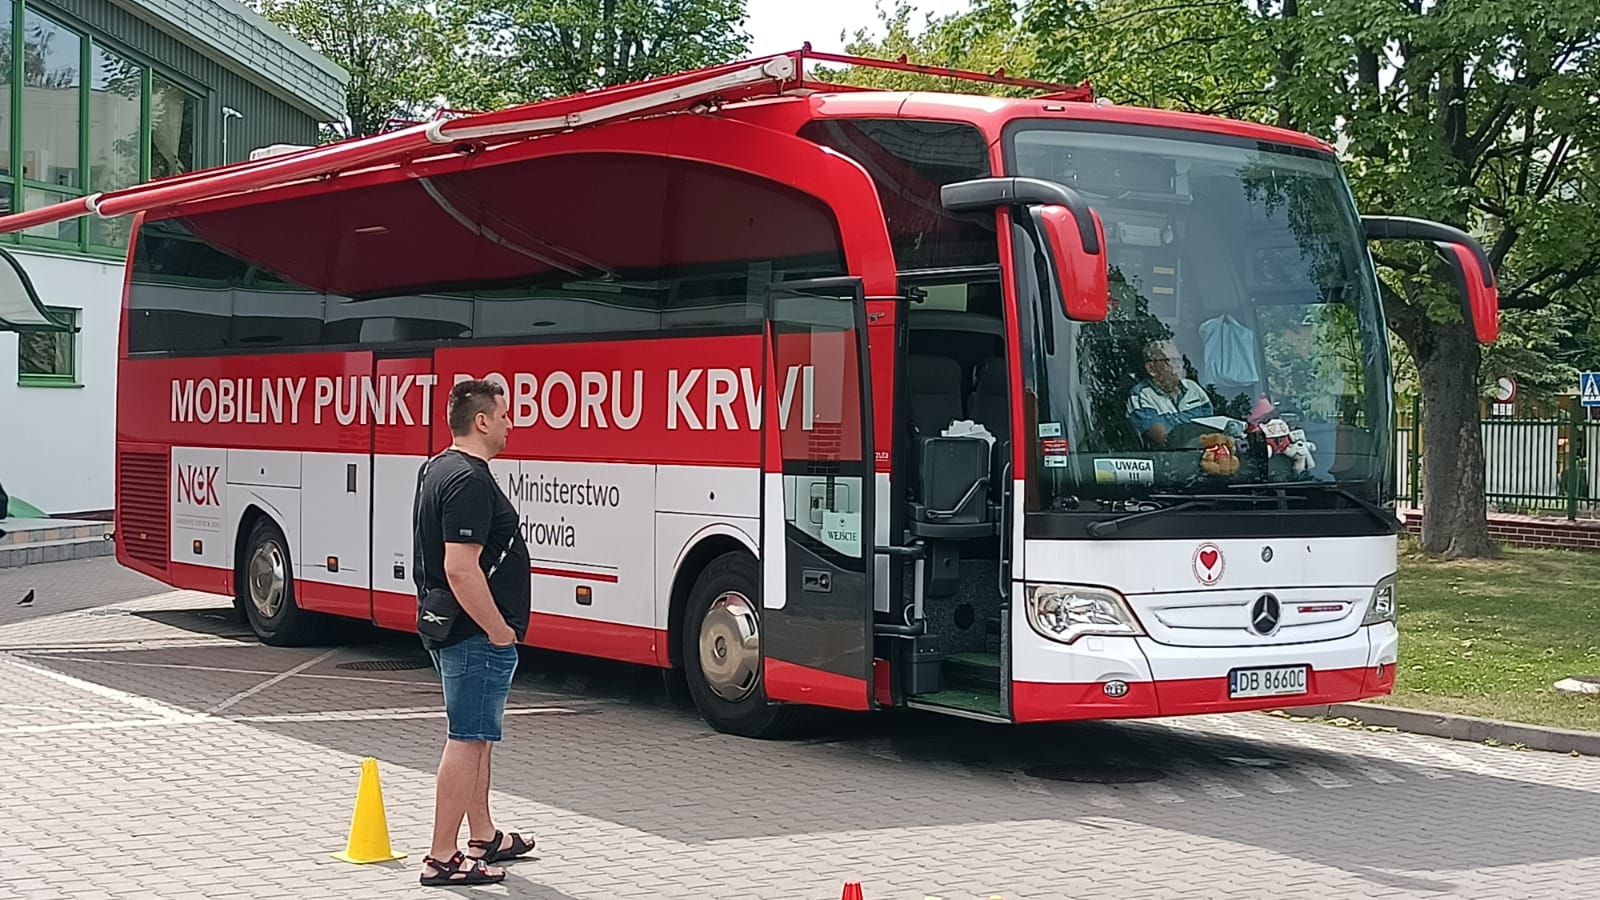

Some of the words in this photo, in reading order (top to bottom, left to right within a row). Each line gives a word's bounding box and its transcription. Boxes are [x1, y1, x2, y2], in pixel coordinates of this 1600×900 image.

[171, 377, 307, 424] MOBILNY
[314, 373, 438, 427] PUNKT
[666, 364, 815, 432] KRWI
[1115, 460, 1151, 472] UWAGA
[177, 463, 220, 506] NCK
[508, 472, 620, 507] Ministerstwo
[519, 514, 576, 548] drowia
[1239, 672, 1260, 692] DB
[1264, 669, 1305, 690] 8660C
